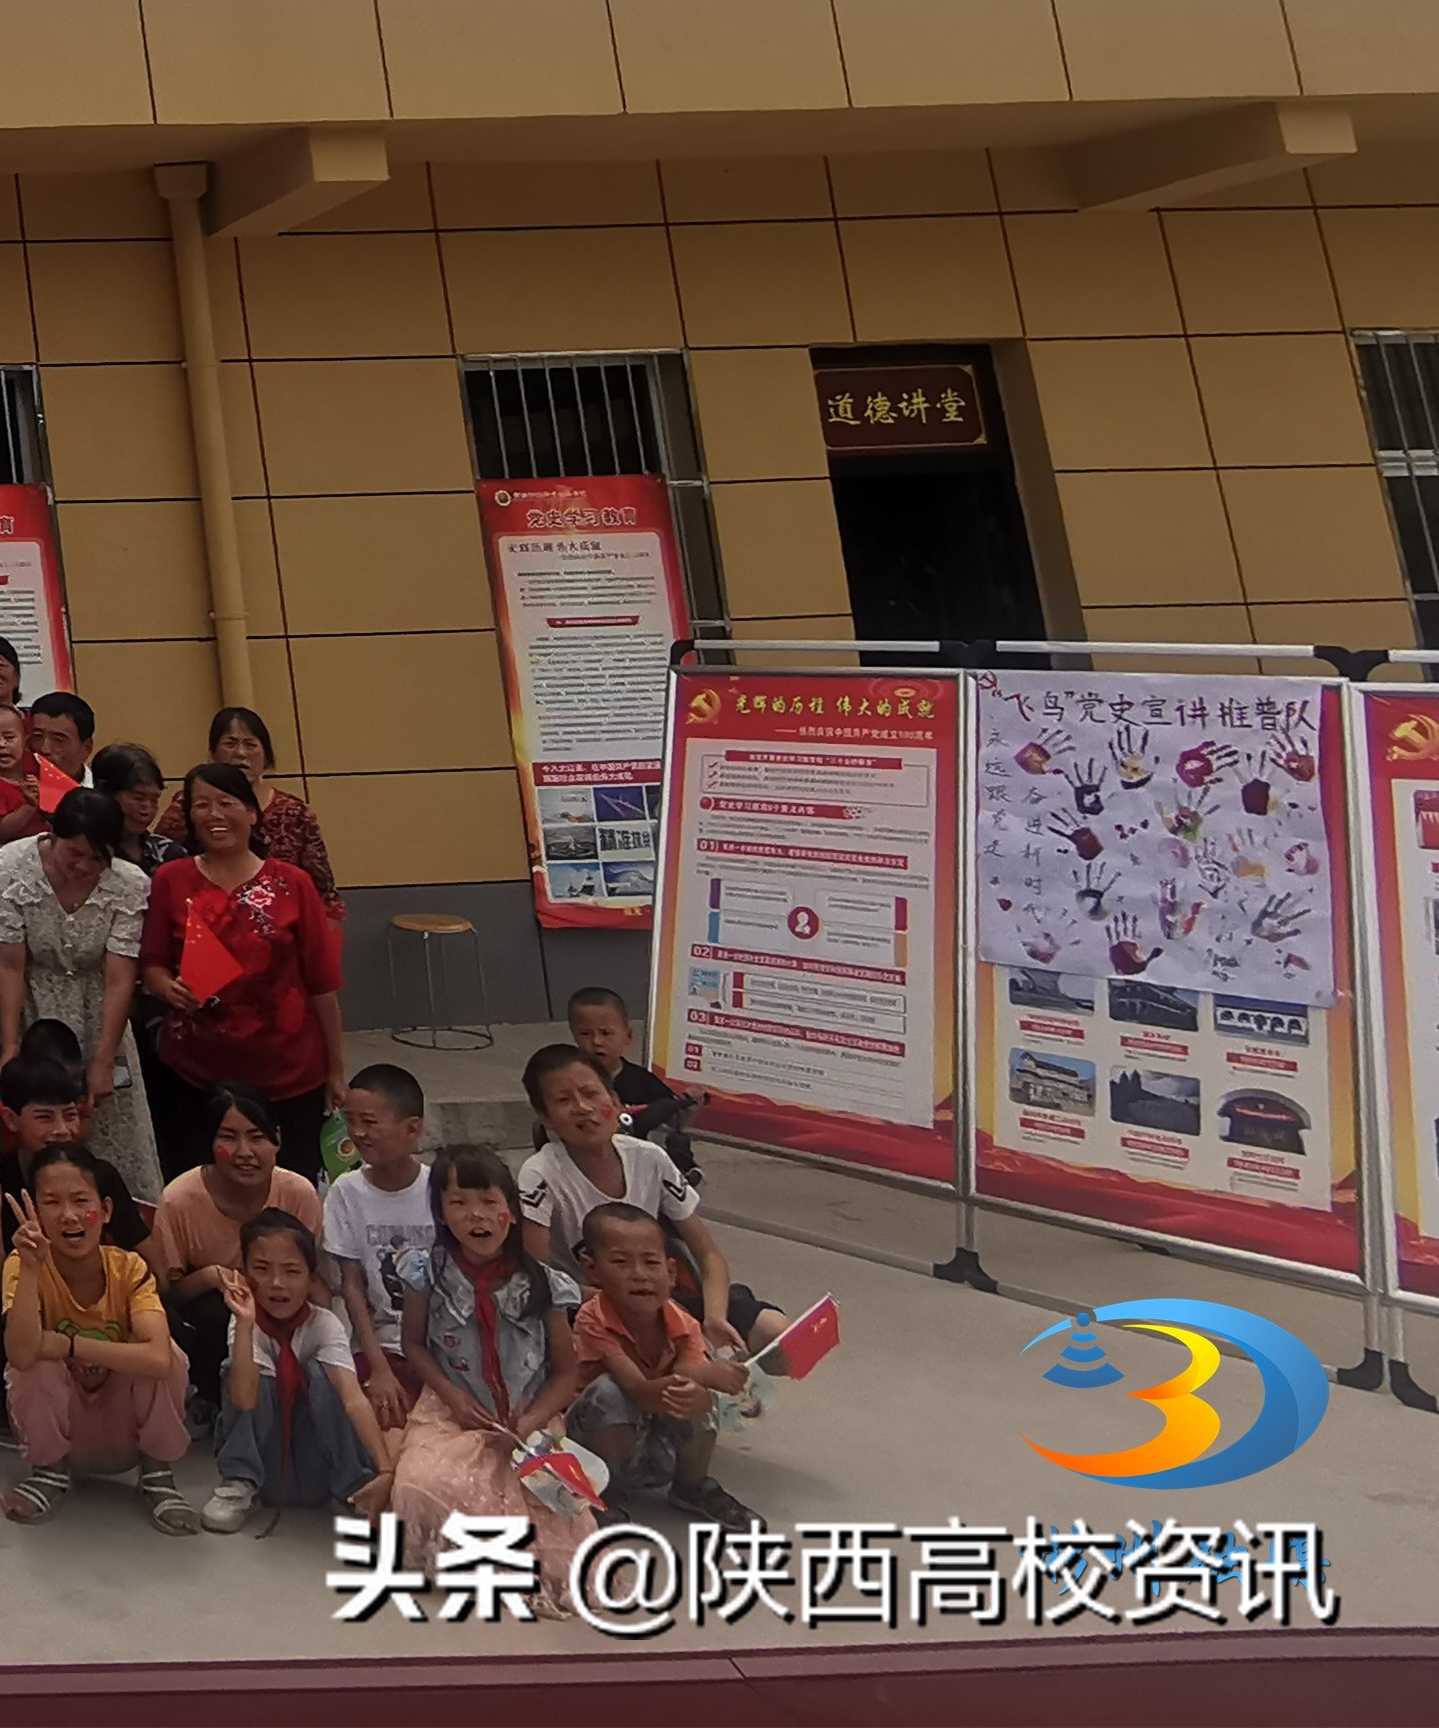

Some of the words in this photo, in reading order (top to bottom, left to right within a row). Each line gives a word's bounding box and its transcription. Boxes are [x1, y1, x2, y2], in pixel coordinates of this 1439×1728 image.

[826, 387, 967, 426] 道德讲堂
[526, 507, 638, 529] 党史学习教育
[734, 693, 826, 716] 光辉的历程
[835, 695, 936, 720] 伟大的成就
[991, 689, 1317, 733] “飞鸟”党史宣讲推普队
[693, 945, 710, 958] 02
[689, 1010, 706, 1023] 03
